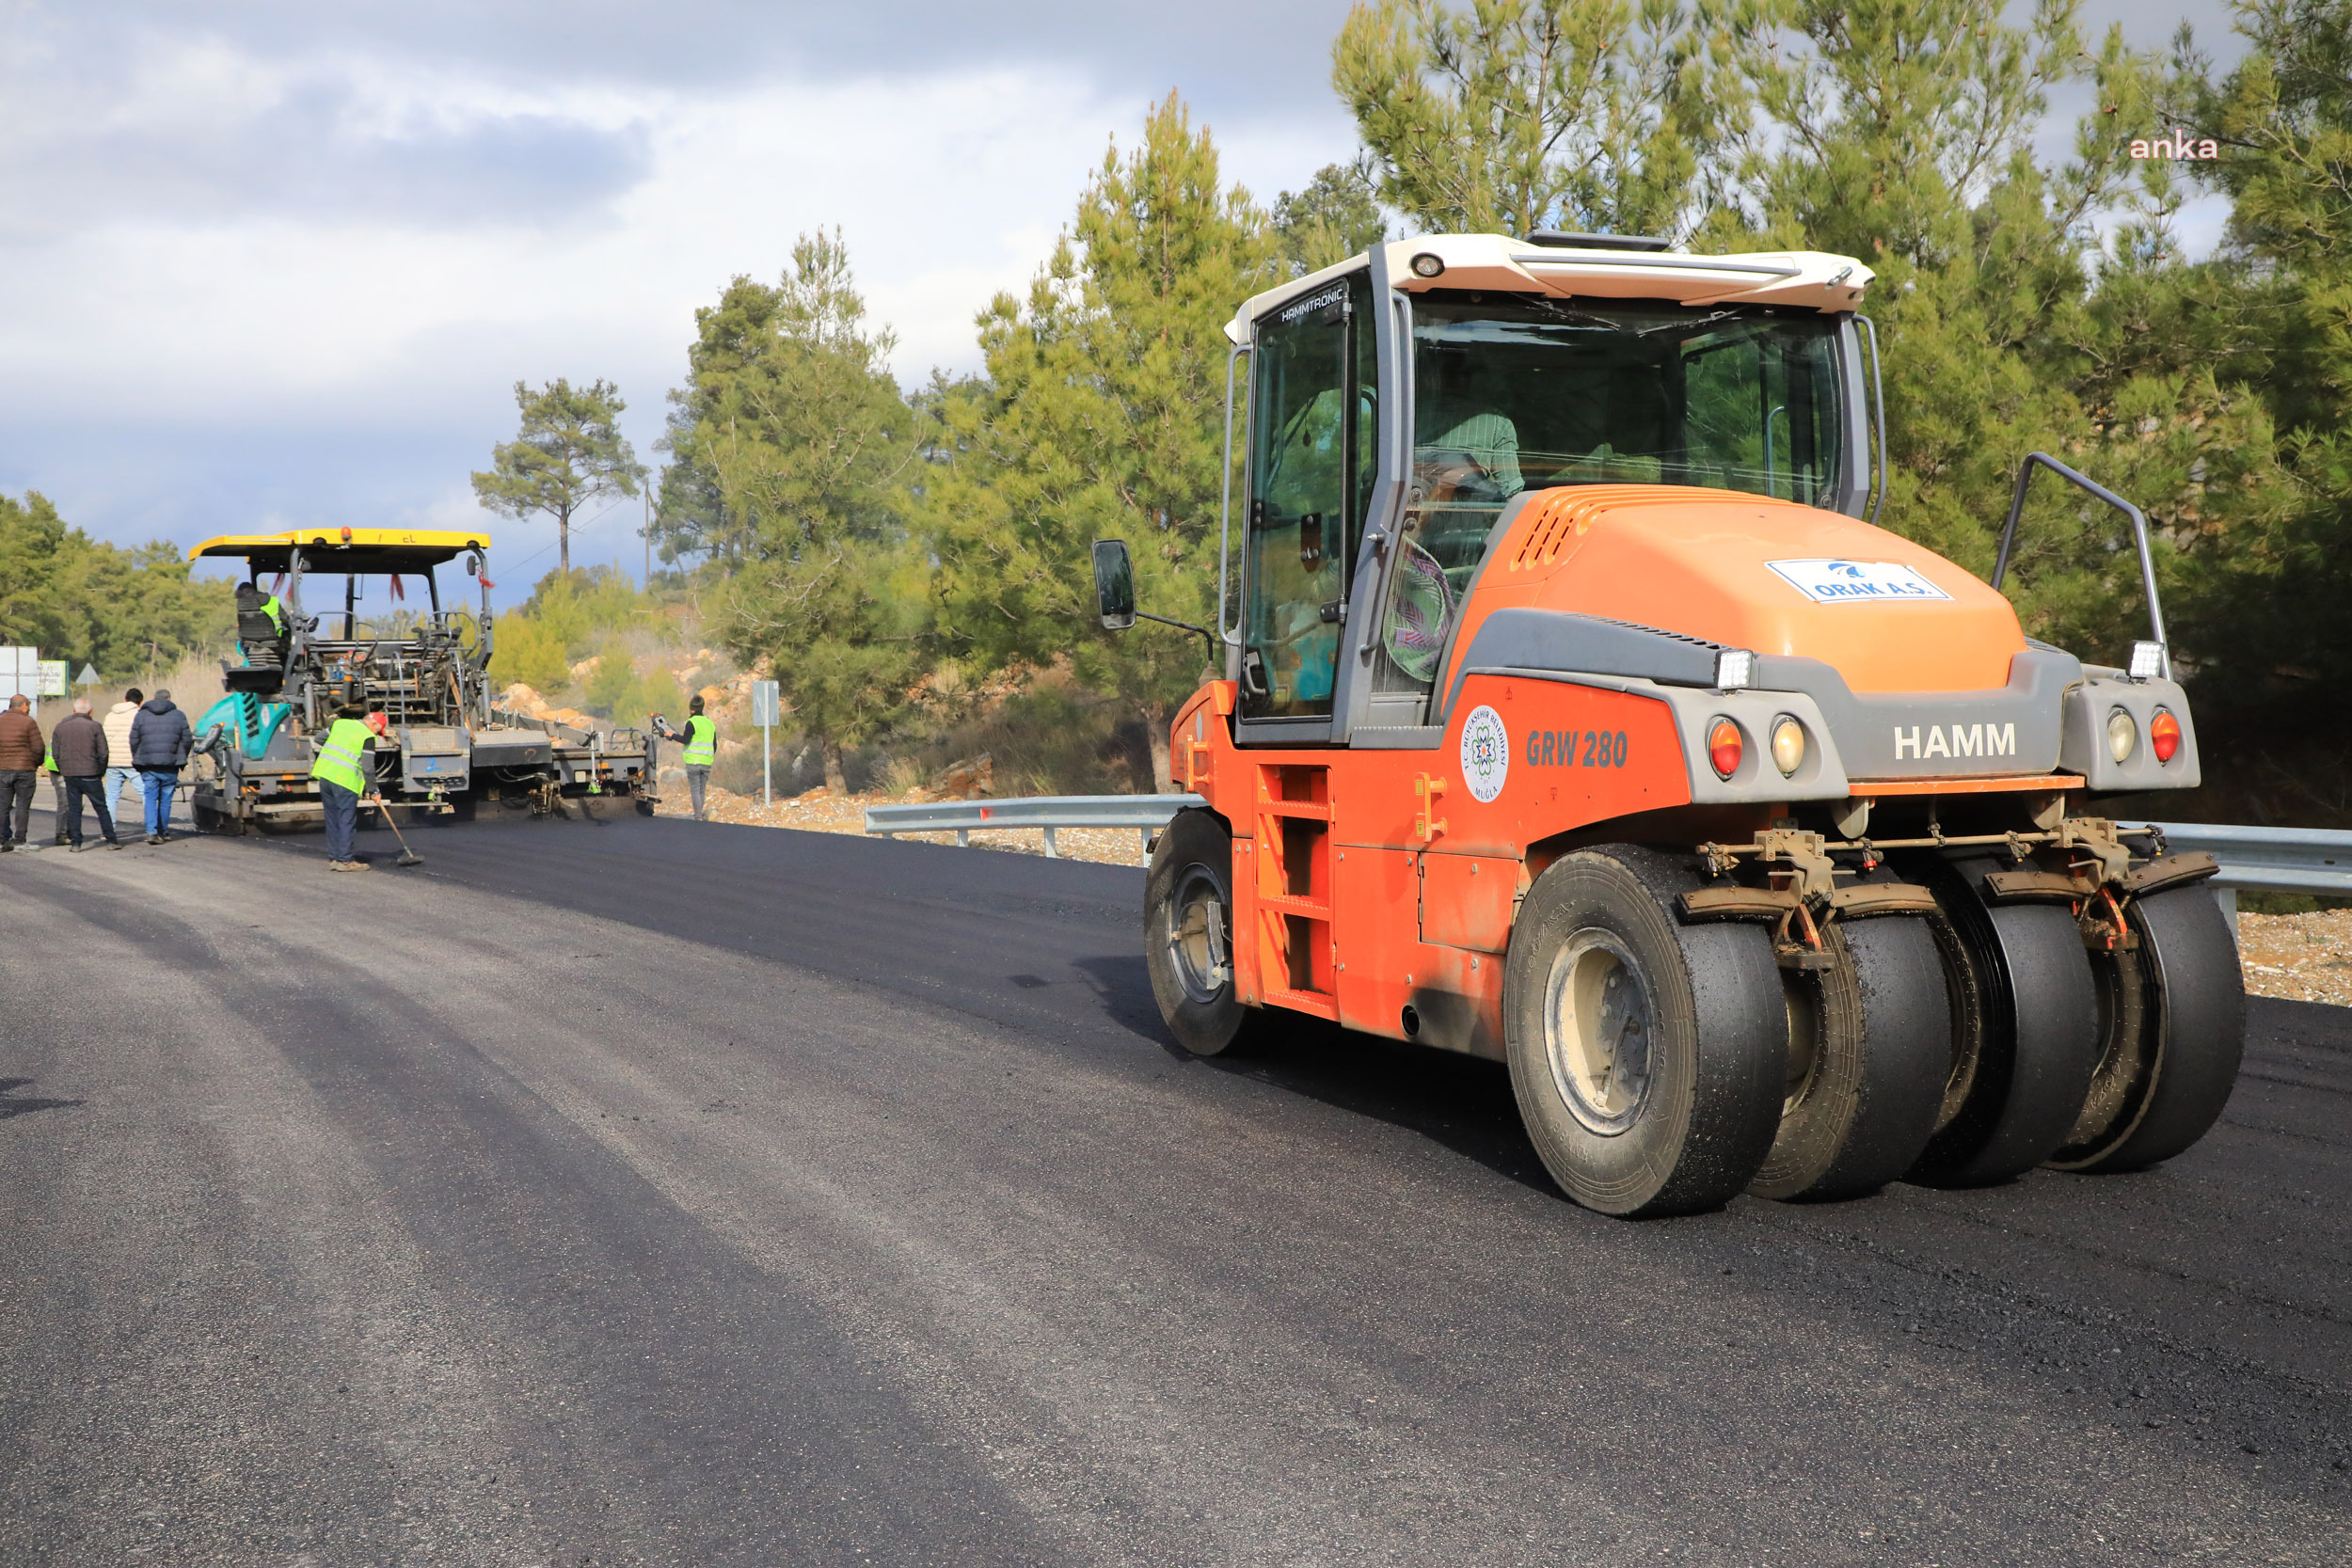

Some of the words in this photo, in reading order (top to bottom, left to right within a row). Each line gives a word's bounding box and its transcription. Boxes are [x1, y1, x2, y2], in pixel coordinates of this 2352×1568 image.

[1281, 288, 1343, 322] HAMMTRONIC
[1814, 582, 1885, 596] ORAK
[1886, 582, 1931, 594] A.Ş.
[1526, 730, 1579, 767] GRW
[1582, 730, 1628, 768] 280
[1894, 722, 2015, 760] HAMM
[425, 757, 443, 773] 2
[1475, 785, 1499, 800] MUĞLA
